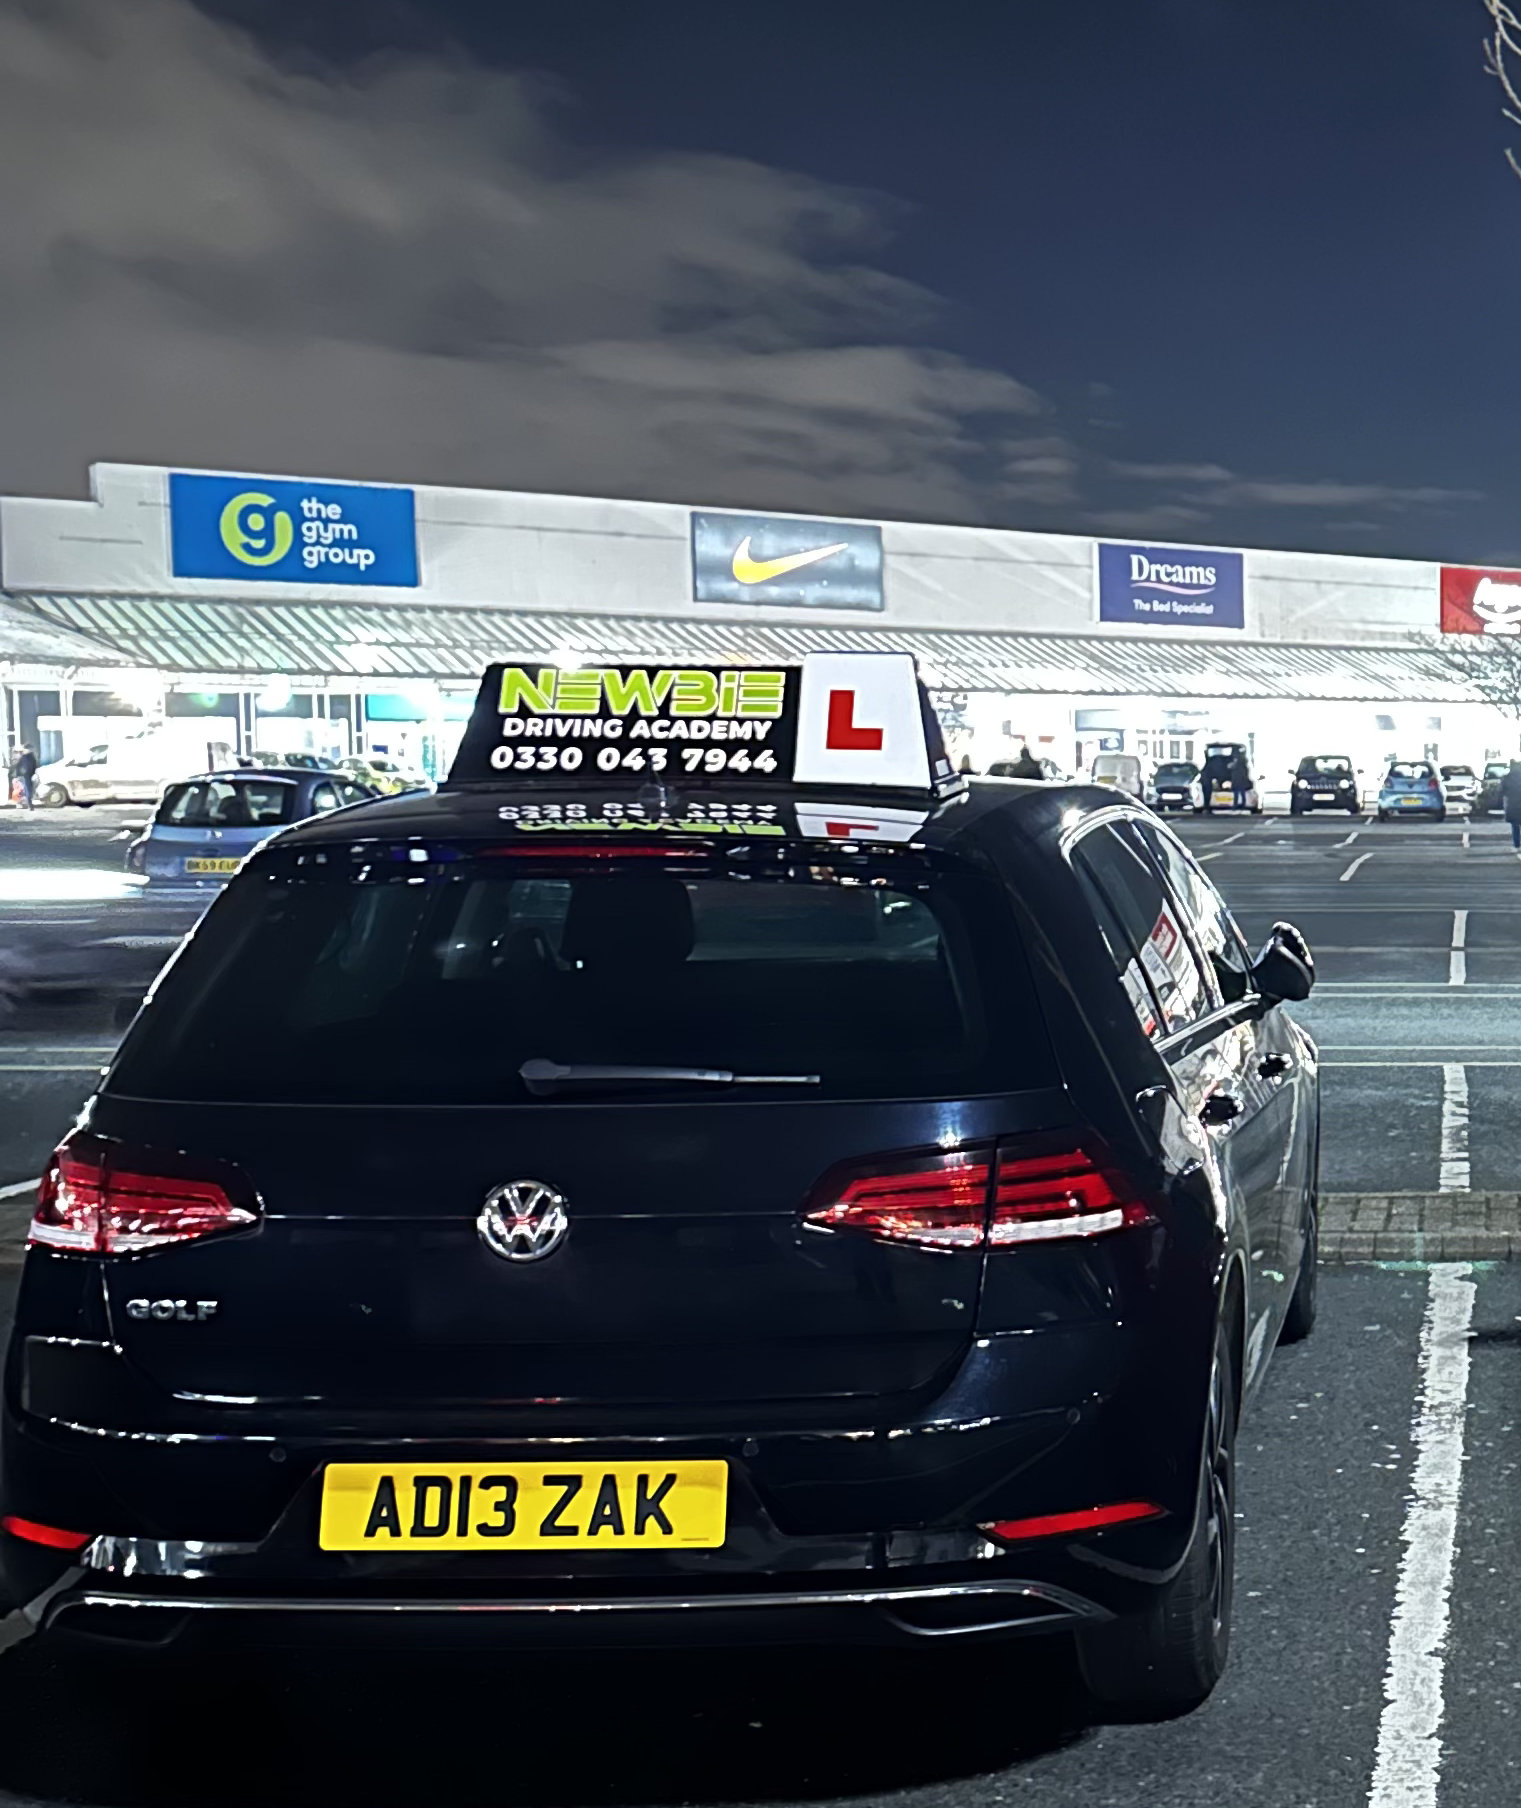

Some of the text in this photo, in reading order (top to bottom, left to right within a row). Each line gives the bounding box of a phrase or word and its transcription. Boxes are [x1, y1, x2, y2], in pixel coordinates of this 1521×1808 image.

[301, 497, 342, 520] the
[301, 520, 358, 545] gym
[302, 546, 376, 571] group
[1130, 554, 1217, 586] Dreams
[1133, 598, 1215, 616] The Bed Specialist
[502, 717, 773, 740] DRIVING ACADEMY
[826, 689, 884, 751] L
[490, 746, 778, 773] 0330 043 7944
[126, 1299, 218, 1321] GOLF
[363, 1473, 678, 1538] AD13 ZAK
